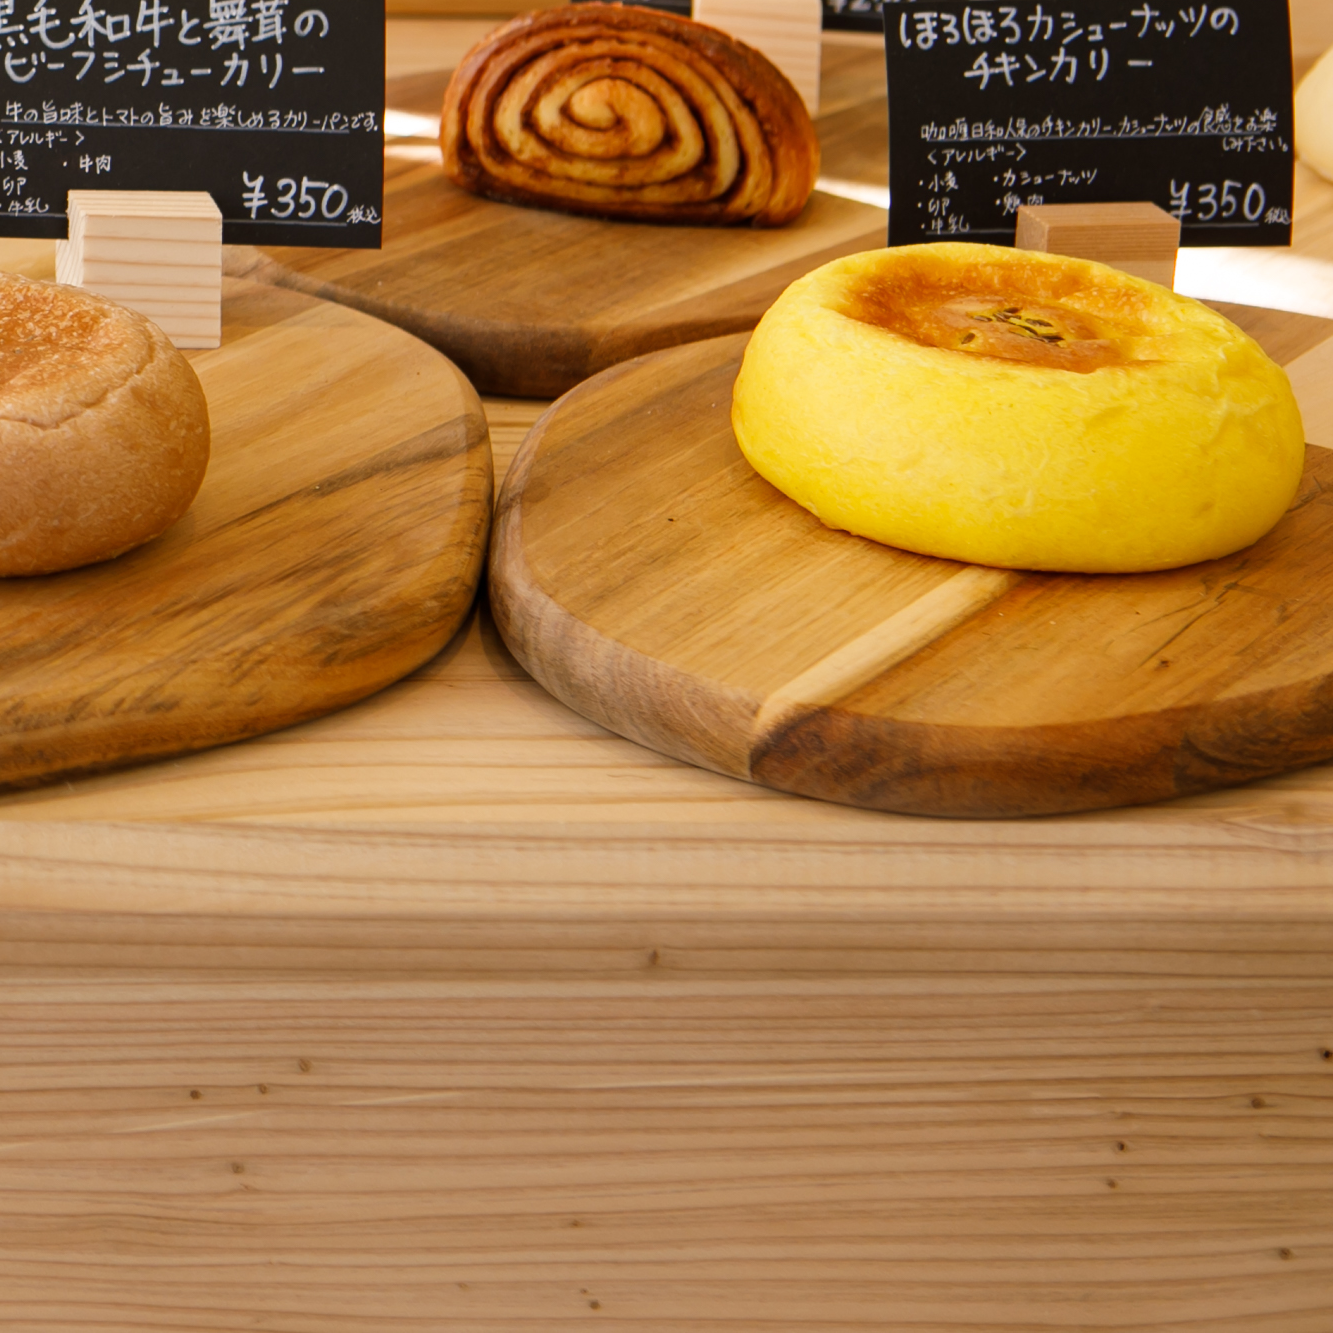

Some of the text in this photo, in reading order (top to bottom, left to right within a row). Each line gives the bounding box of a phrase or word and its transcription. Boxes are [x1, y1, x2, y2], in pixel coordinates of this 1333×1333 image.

[899, 1, 1241, 50] ほろほろカシューナッツの
[4, 49, 325, 89] ビーフシチューカリー
[963, 46, 1154, 90] チキンカリー
[242, 170, 349, 221] ¥350
[1169, 177, 1267, 222] ¥350
